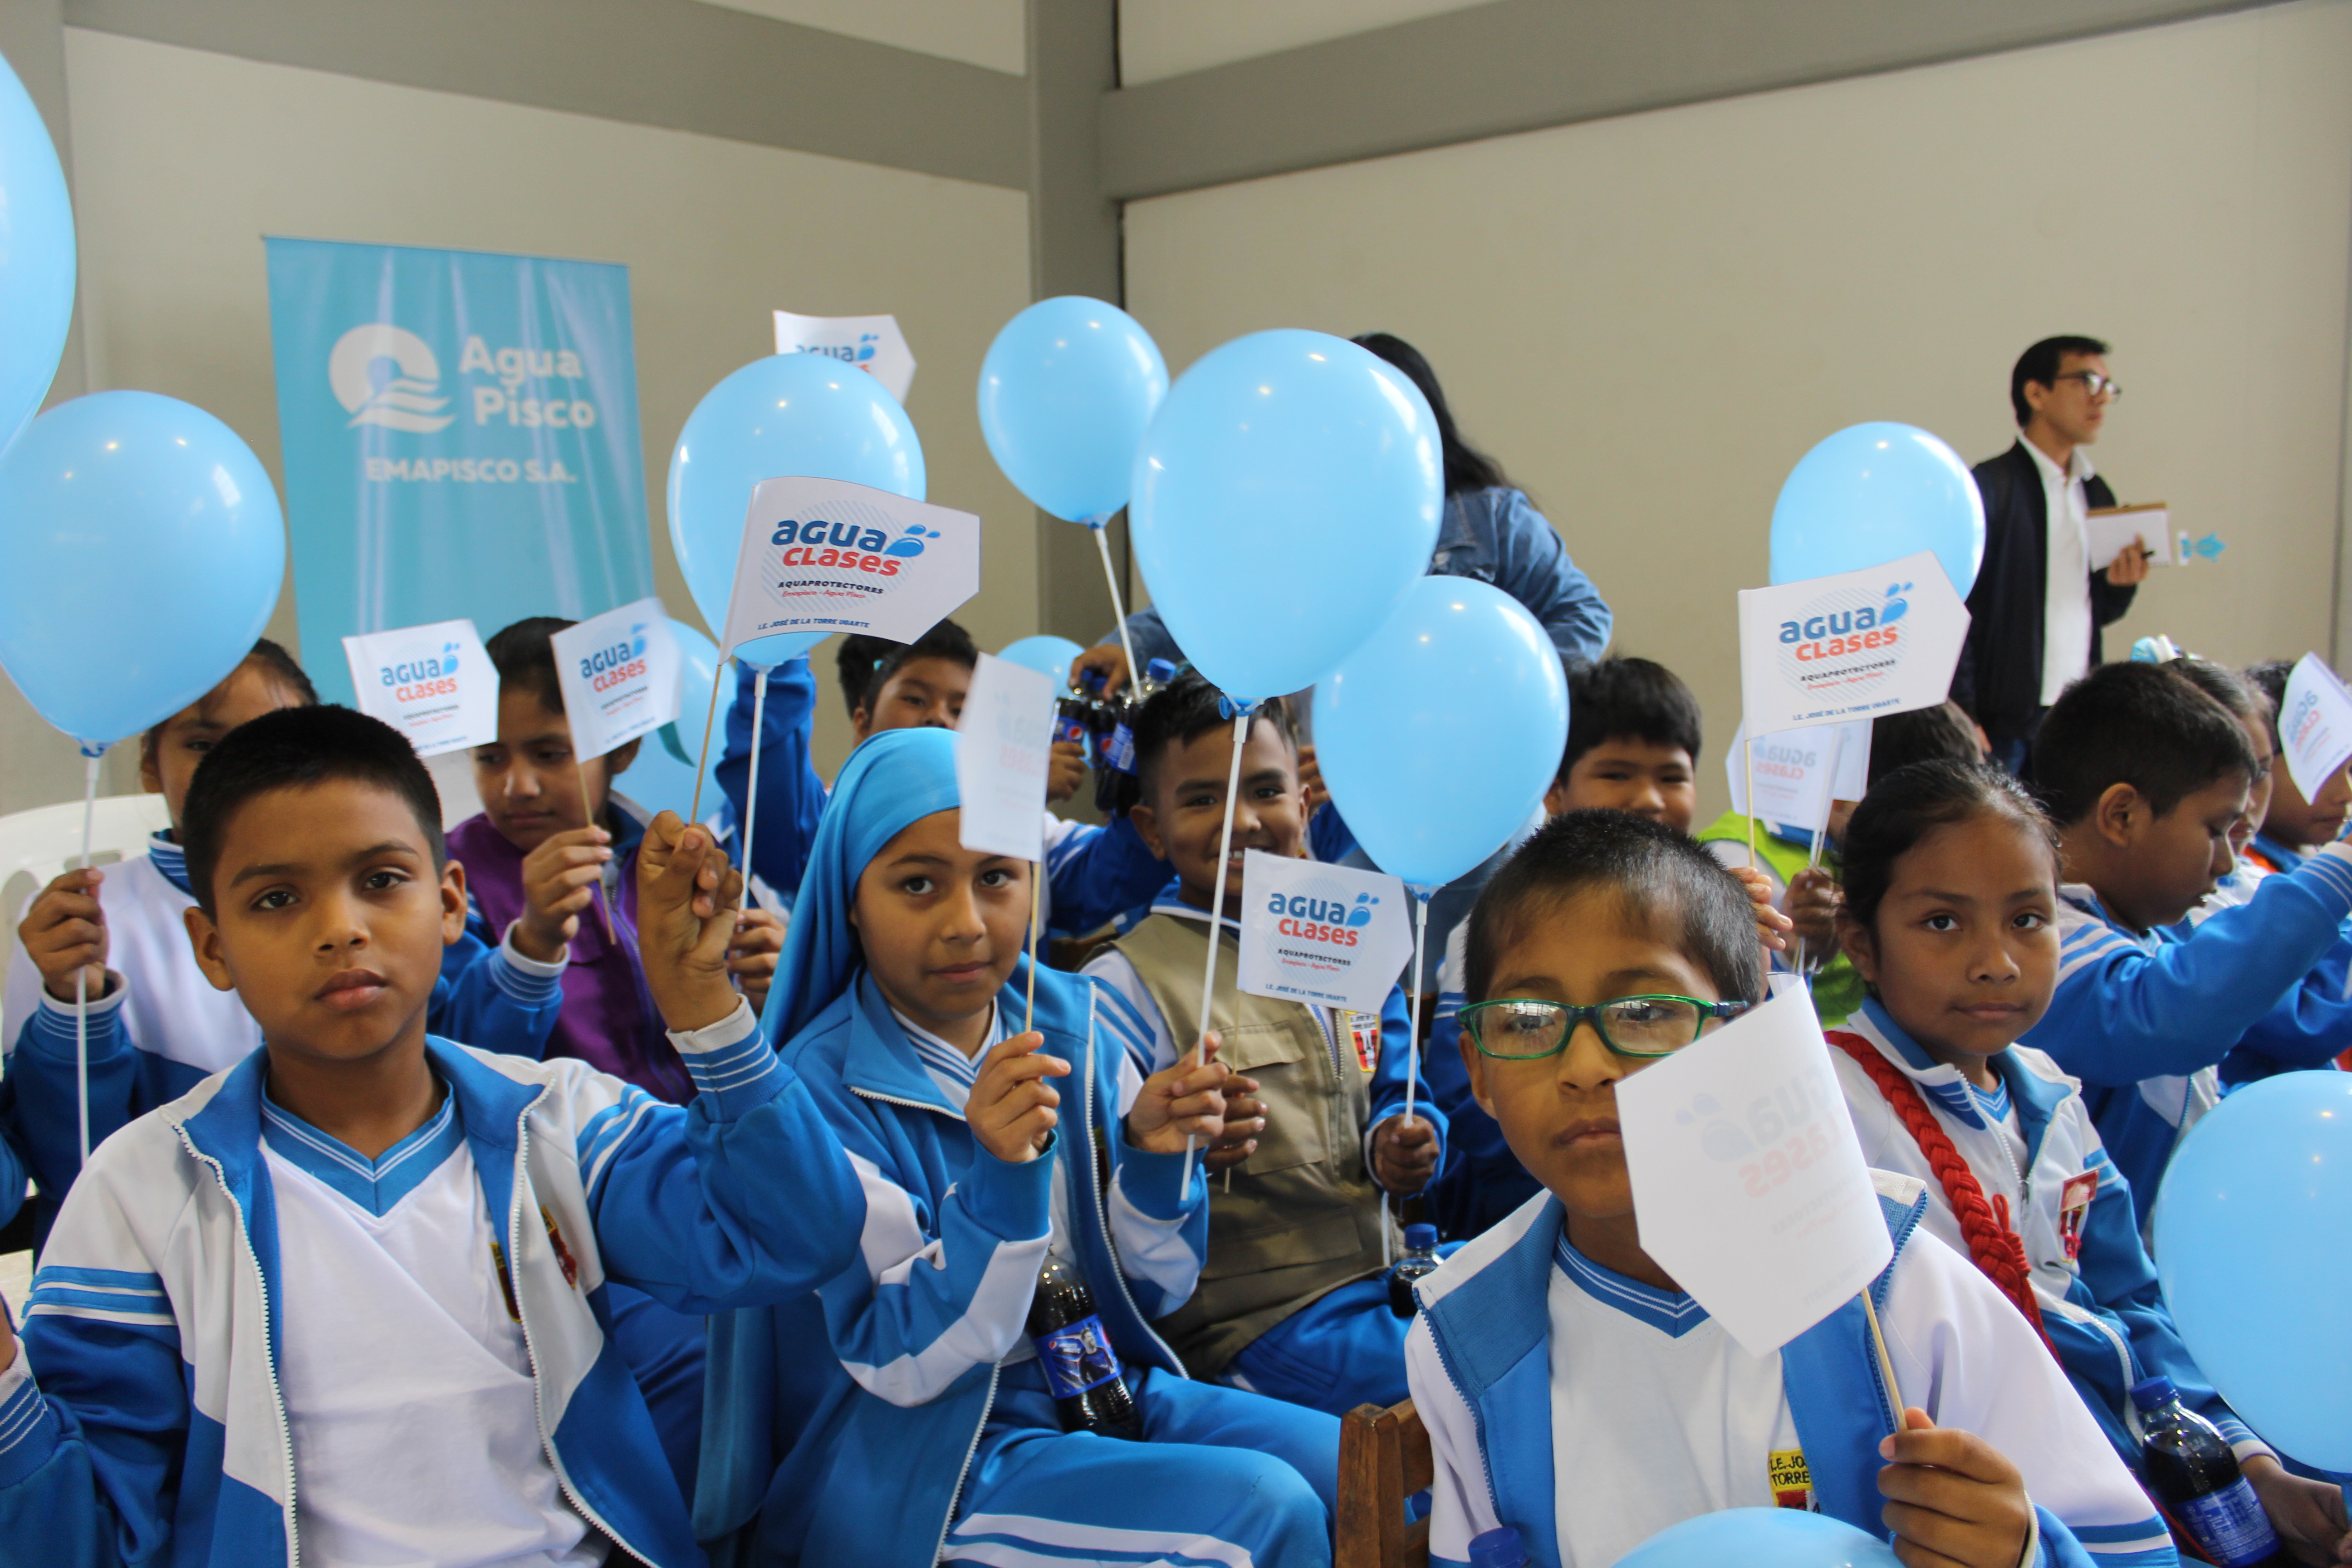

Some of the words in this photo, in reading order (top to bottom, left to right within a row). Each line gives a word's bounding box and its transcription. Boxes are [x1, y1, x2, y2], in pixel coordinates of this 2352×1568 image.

[459, 335, 584, 386] Agua
[473, 385, 596, 428] Pisco
[366, 457, 519, 483] EMAPISCO
[524, 460, 578, 484] S.A.
[778, 580, 884, 594] AQUAPROTECTORES
[823, 590, 844, 598] Agua
[839, 620, 870, 628] UGARTE
[1278, 948, 1351, 966] AQUAPROTECTORES
[1788, 1455, 1807, 1469] JO
[1771, 1471, 1810, 1486] TORRE
